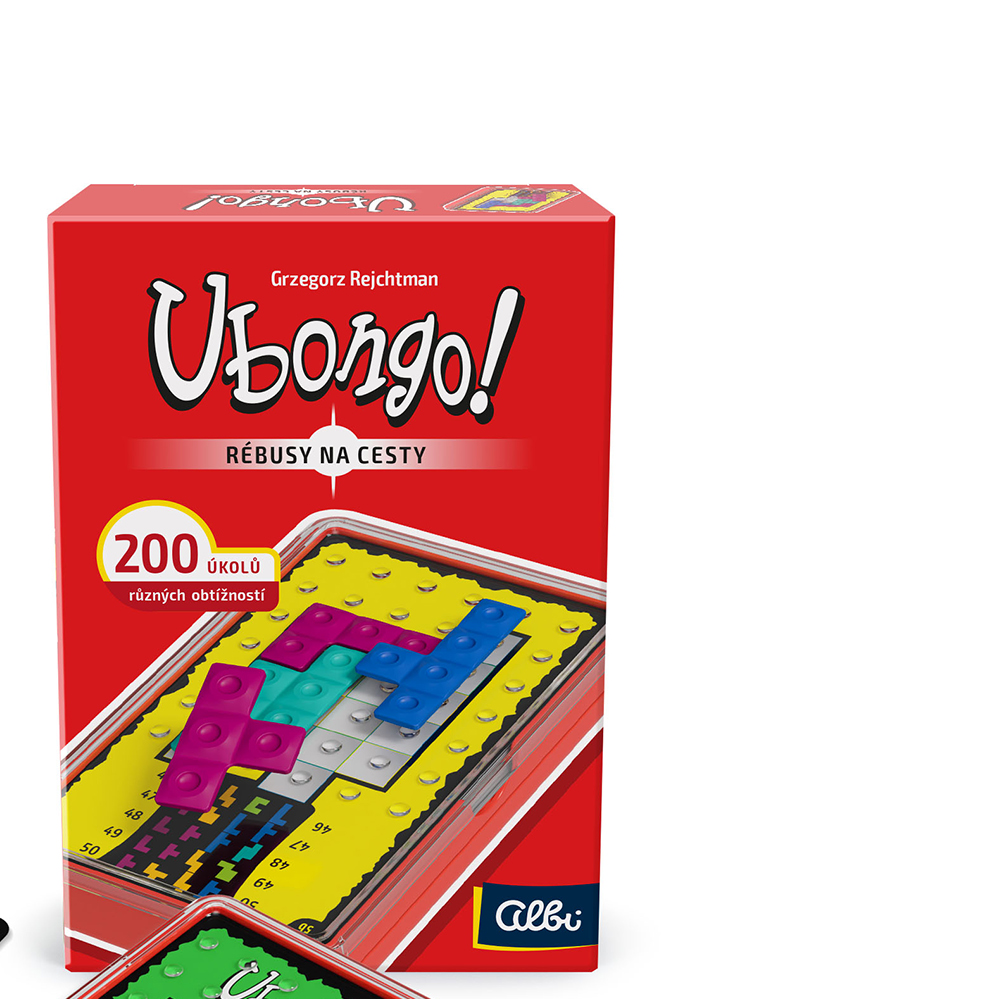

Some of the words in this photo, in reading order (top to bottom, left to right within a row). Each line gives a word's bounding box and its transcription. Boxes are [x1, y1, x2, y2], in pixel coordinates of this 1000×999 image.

[182, 194, 417, 212] Ubongo!
[271, 270, 346, 289] Grzegorz
[350, 270, 438, 290] Rejchtman
[147, 272, 525, 427] Ubongo!
[226, 441, 312, 464] RÉBUSY
[320, 446, 350, 464] NA
[358, 446, 427, 464] CESTY
[115, 533, 199, 574] 200
[207, 557, 260, 574] ÚKOLŮ
[129, 588, 186, 604] různých
[191, 588, 266, 602] obtížností
[124, 808, 143, 820] 48
[104, 826, 123, 838] 49
[312, 822, 332, 834] 46
[79, 843, 100, 855] 50
[289, 840, 310, 851] 47
[270, 858, 290, 870] 48
[253, 878, 274, 890] 49
